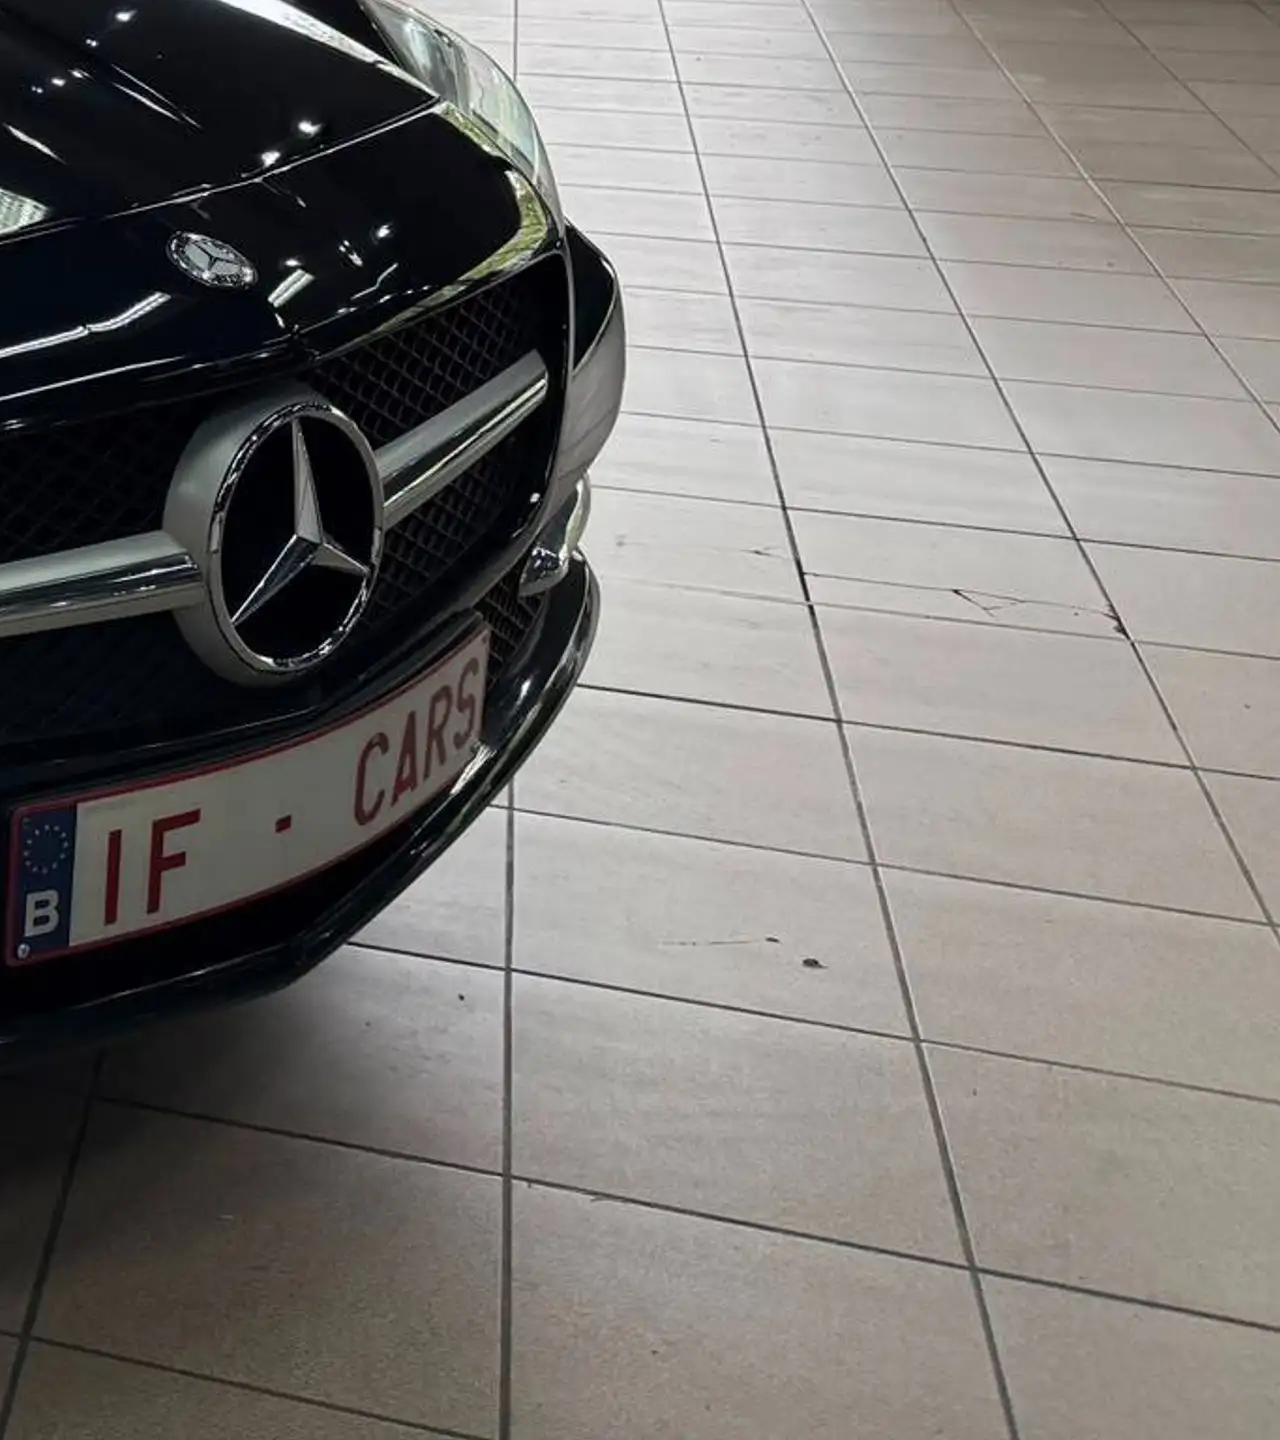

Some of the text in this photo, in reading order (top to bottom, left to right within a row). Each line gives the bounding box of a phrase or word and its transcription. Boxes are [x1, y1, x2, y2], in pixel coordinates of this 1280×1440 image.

[104, 808, 201, 927] IF
[354, 658, 479, 826] CARS
[25, 888, 60, 937] B
